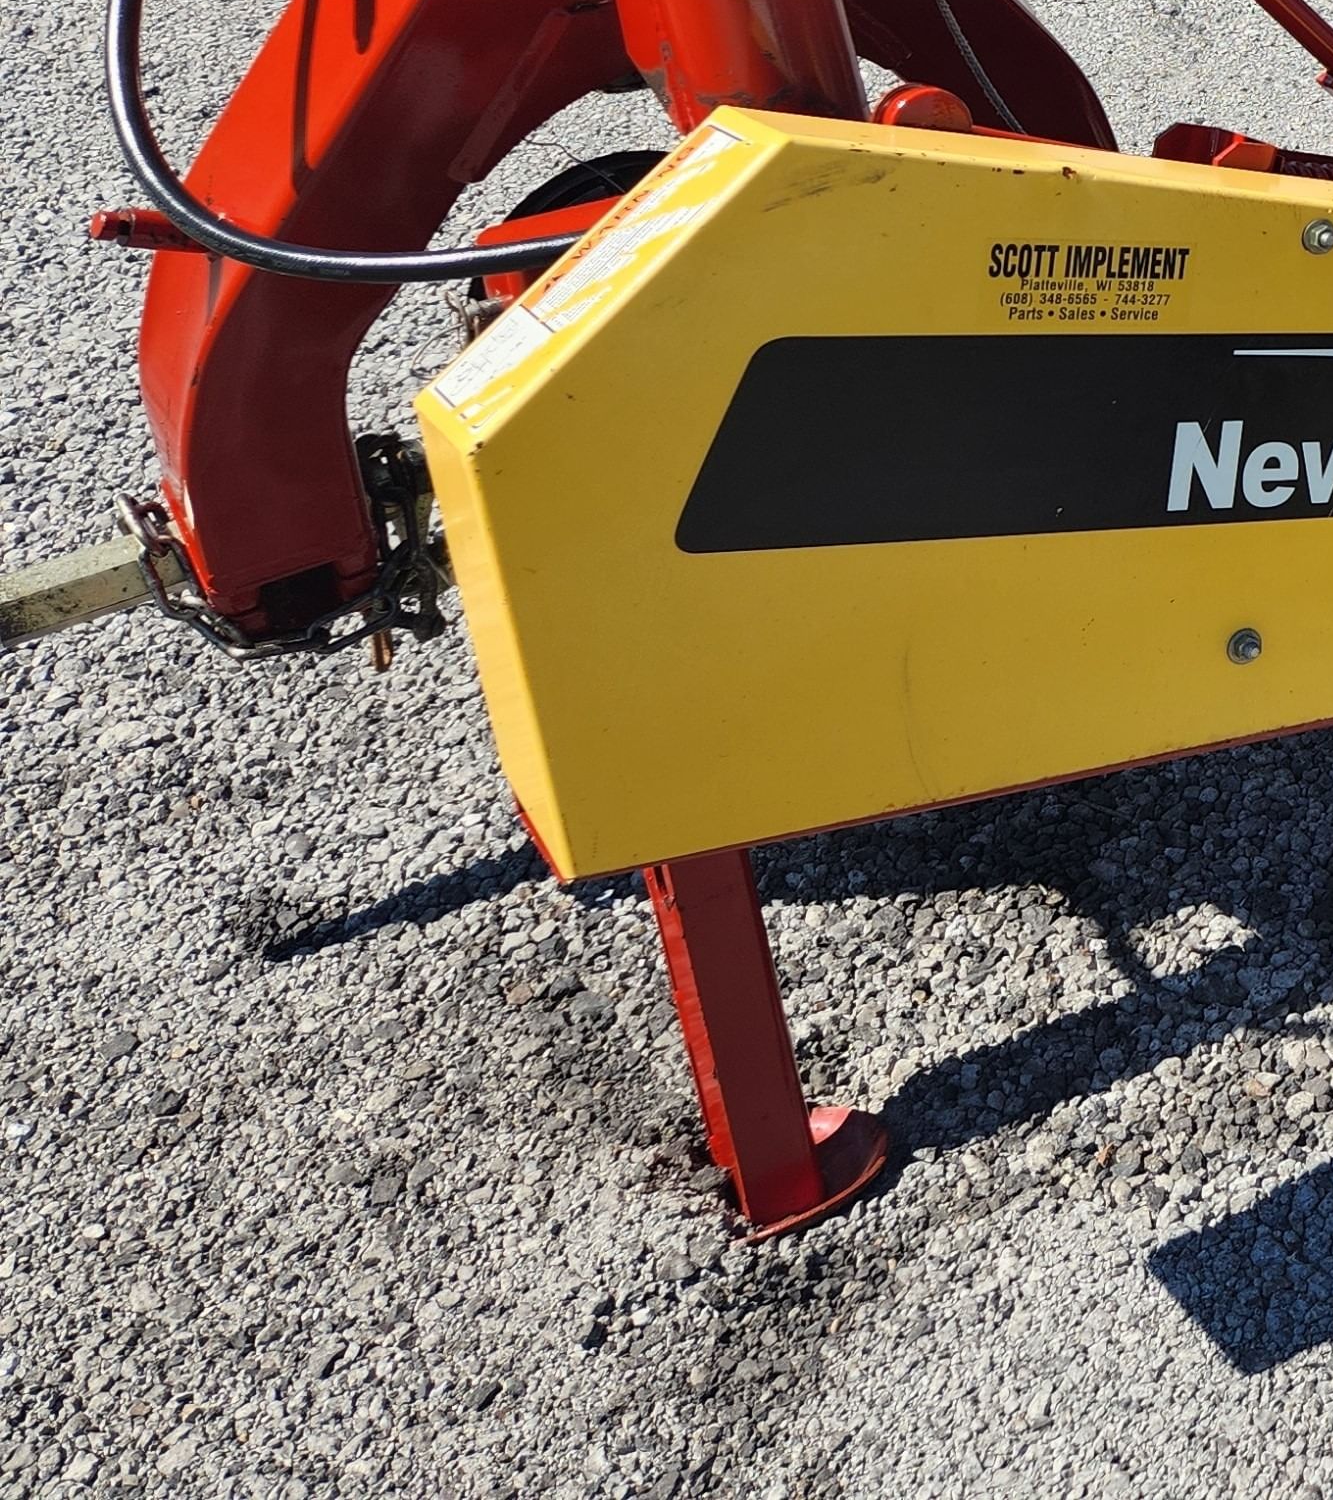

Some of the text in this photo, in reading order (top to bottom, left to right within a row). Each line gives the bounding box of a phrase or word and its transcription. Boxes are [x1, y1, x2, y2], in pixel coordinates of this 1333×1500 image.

[988, 243, 1190, 280] SCOTT IMPLEMENT
[1020, 278, 1154, 293] Platteville, WI 53818
[1000, 293, 1033, 307] (608)
[1039, 293, 1097, 305] 348-6565
[1115, 294, 1170, 306] 744-3277
[1008, 307, 1159, 321] Parts Sales Service
